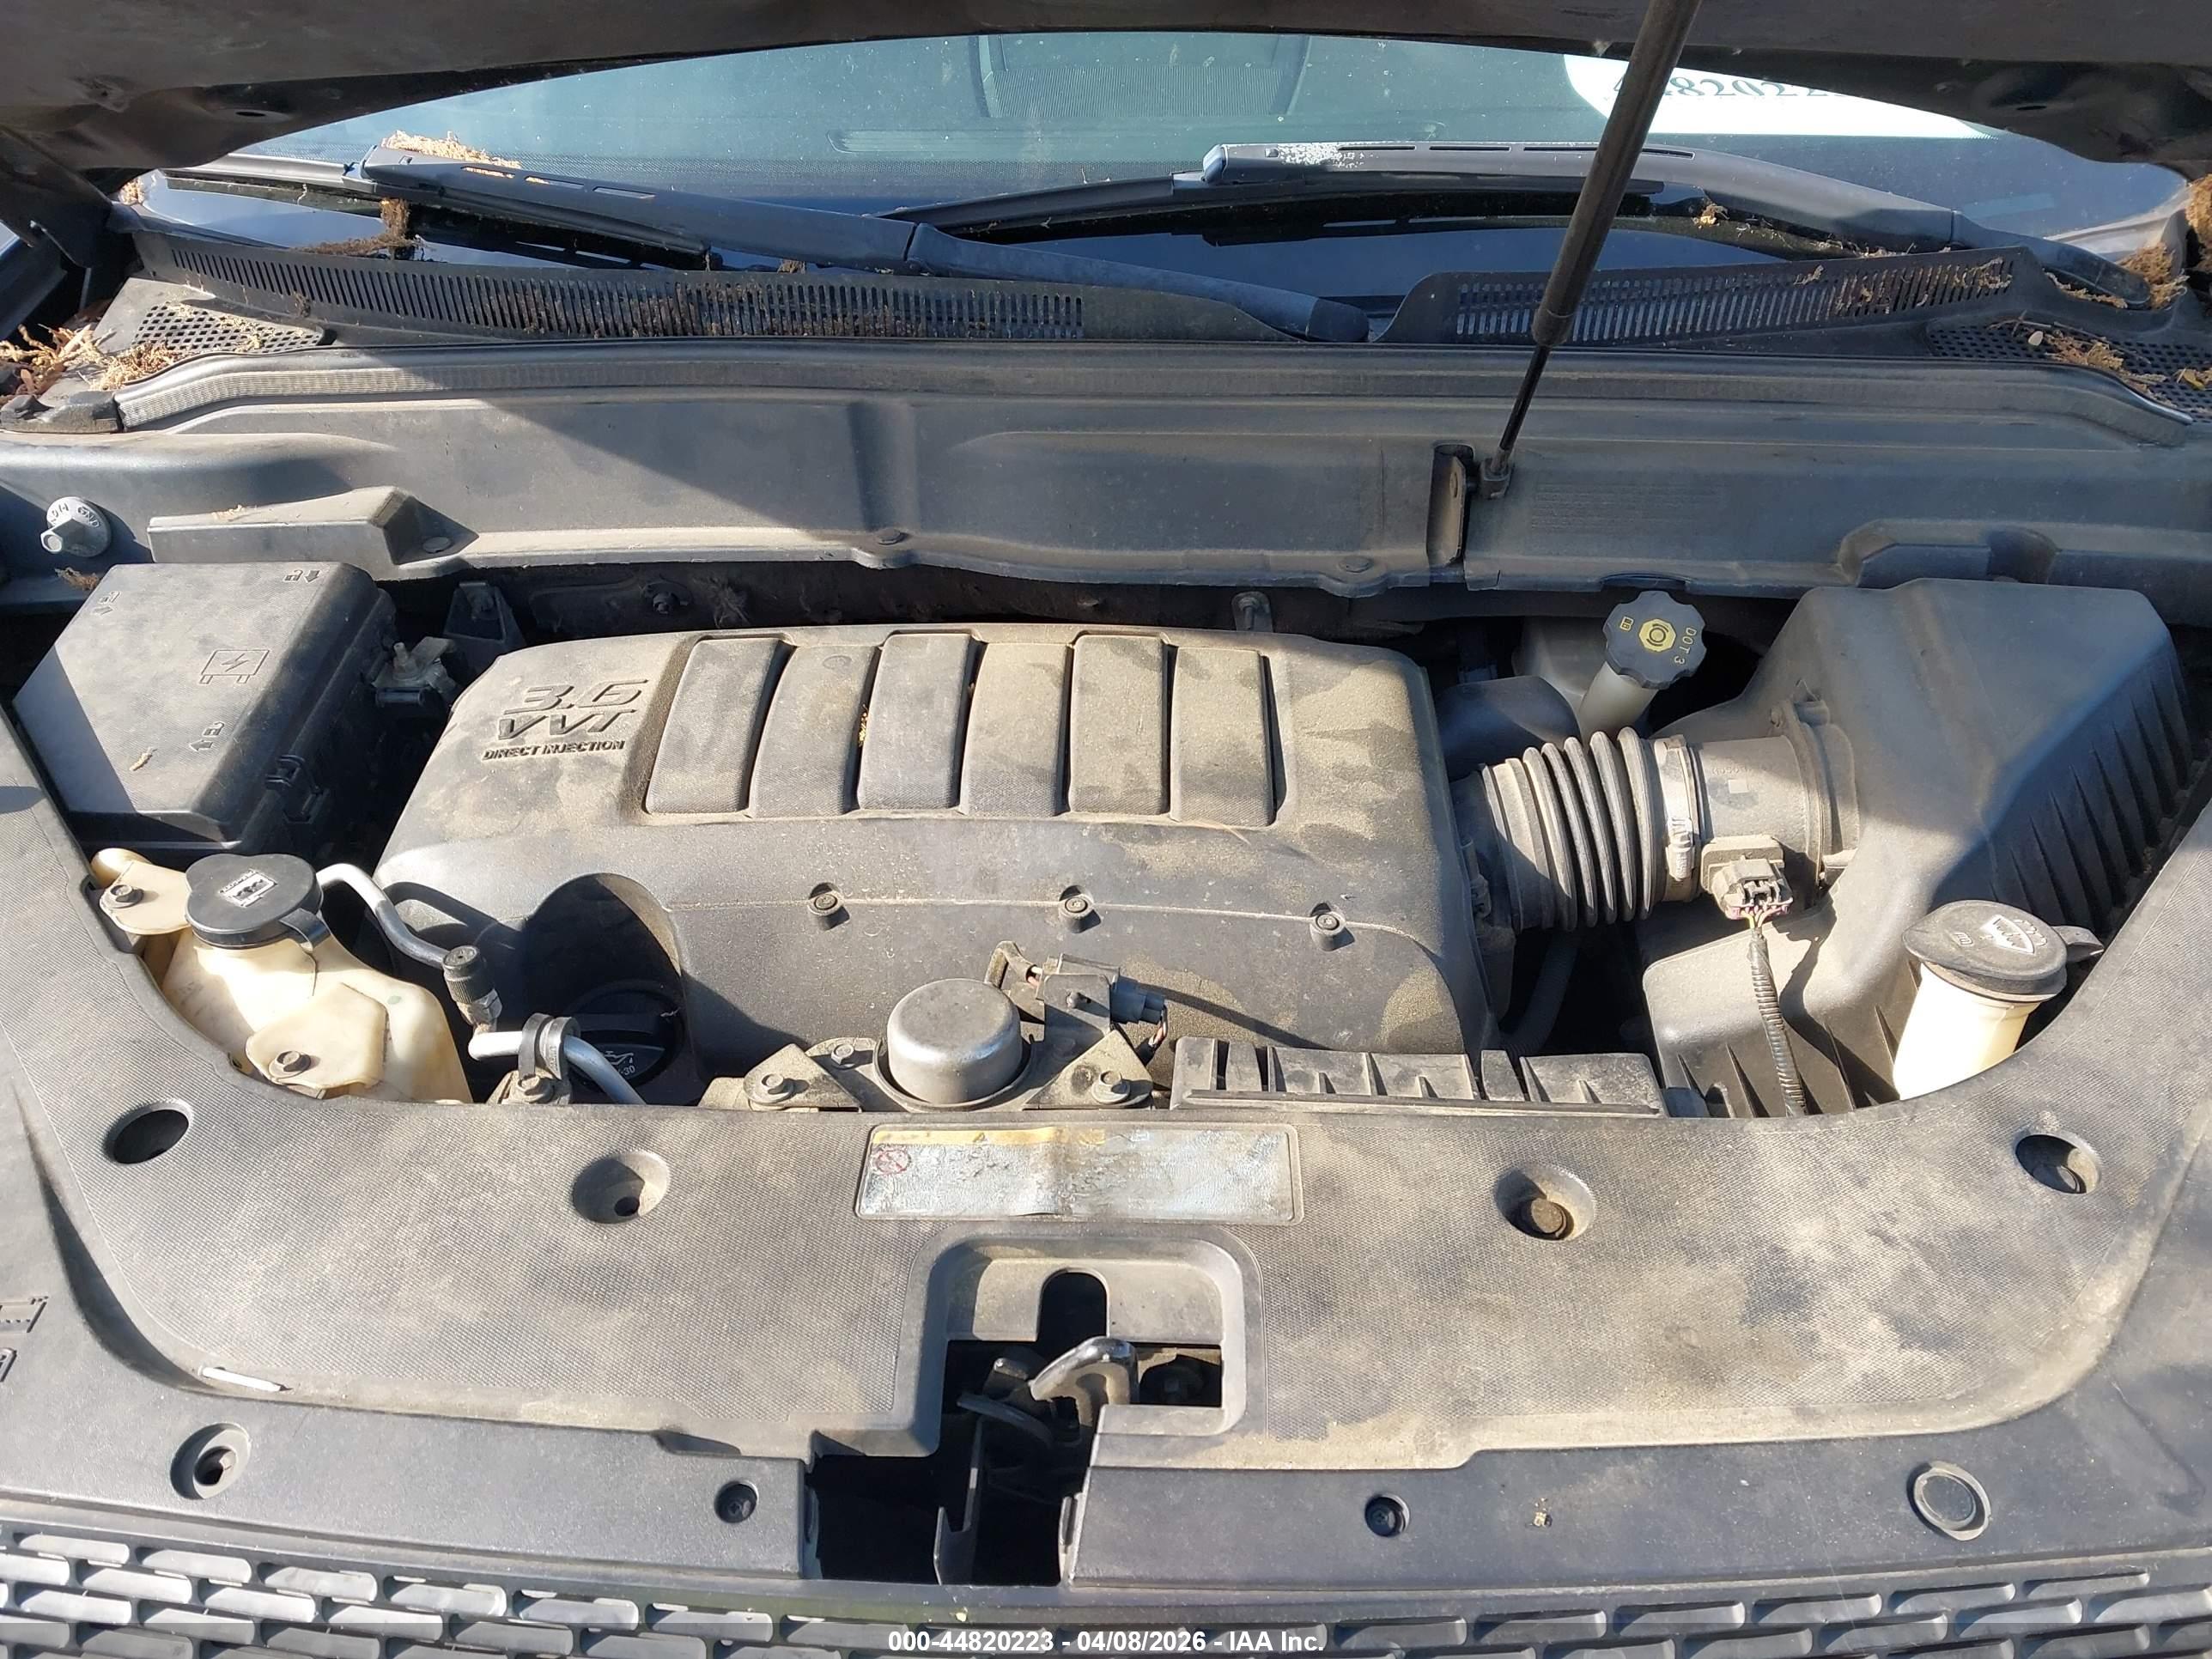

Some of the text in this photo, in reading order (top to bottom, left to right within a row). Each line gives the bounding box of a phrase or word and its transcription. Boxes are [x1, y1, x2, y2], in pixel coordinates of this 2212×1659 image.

[77, 506, 100, 527] GND
[1674, 627, 1698, 665] DOT 3
[503, 678, 649, 715] 3.6
[498, 709, 638, 741] VVT
[482, 740, 626, 762] DIRECT INJECTION
